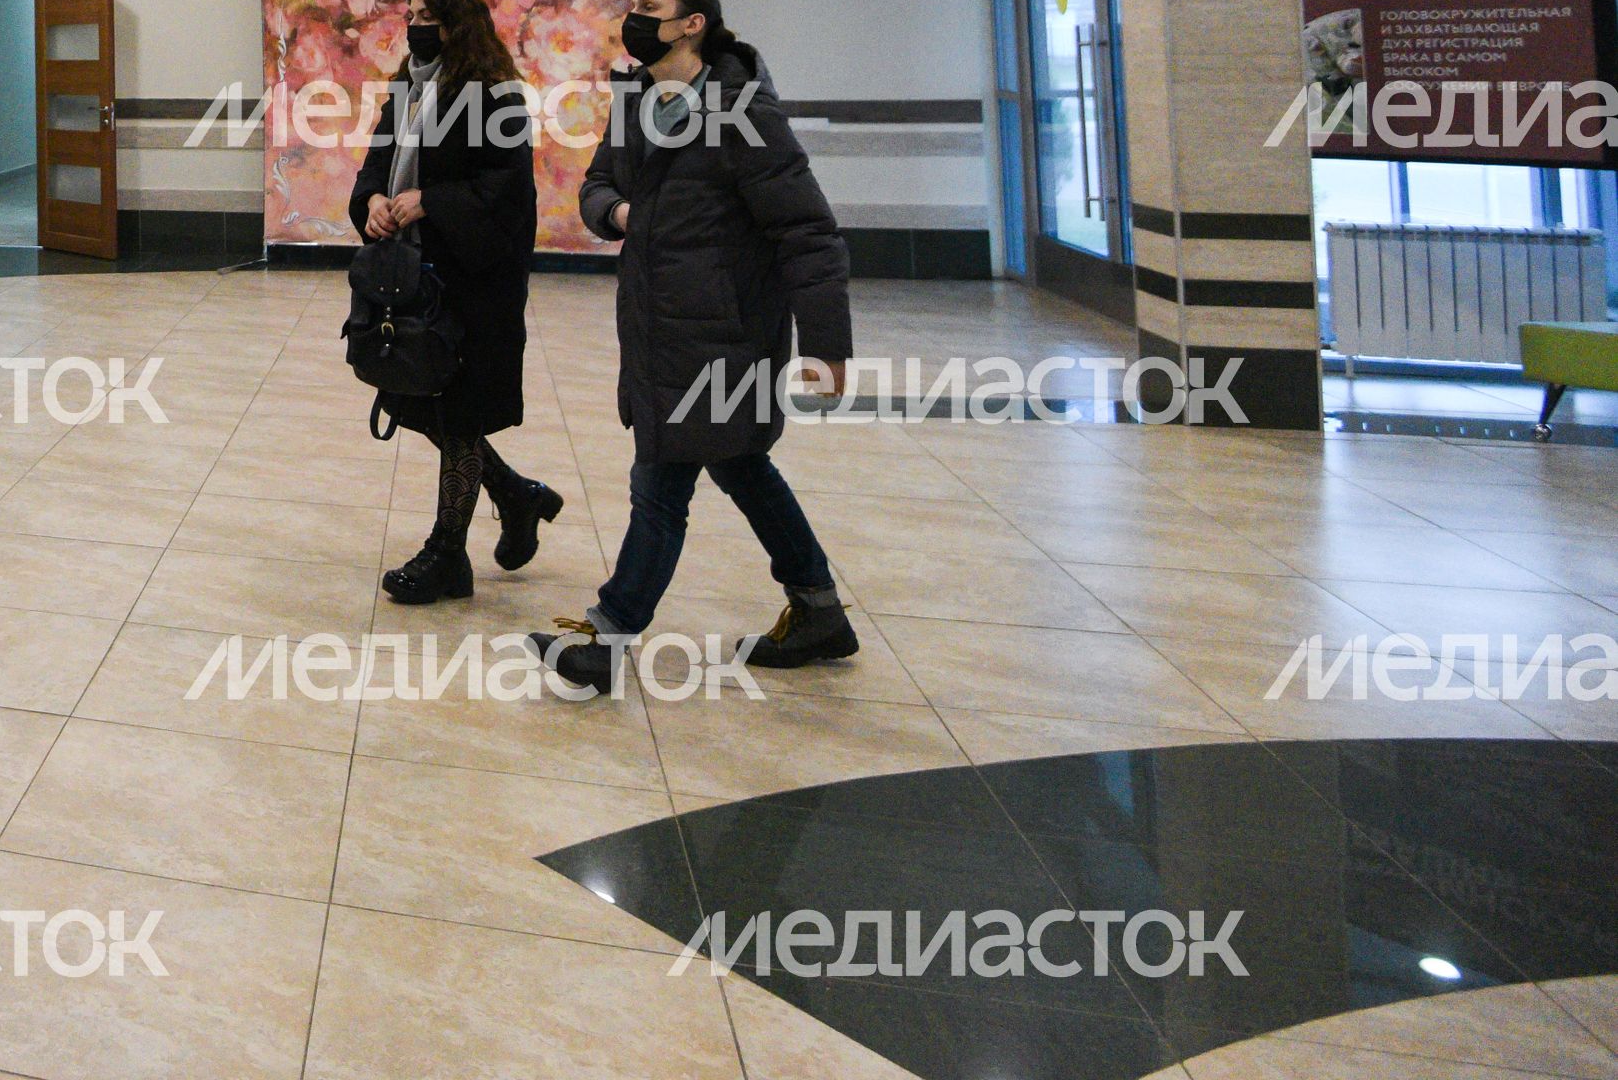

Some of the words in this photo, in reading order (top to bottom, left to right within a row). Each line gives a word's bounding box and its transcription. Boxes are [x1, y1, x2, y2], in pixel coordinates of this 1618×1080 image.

[1380, 7, 1572, 21] ГОЛОВОКРУЖИТЕЛЬНАЯ
[1381, 24, 1391, 34] И
[1395, 23, 1539, 34] ЗАХВАТЫВАЮЩАЯ
[1382, 38, 1412, 50] ДУХ
[1416, 37, 1524, 49] РЕГИСТРАЦИЯ
[1383, 53, 1430, 63] БРАКА
[1434, 53, 1443, 62] В
[1446, 52, 1507, 63] САМОМ
[1384, 67, 1459, 77] ВЫСОКОМ
